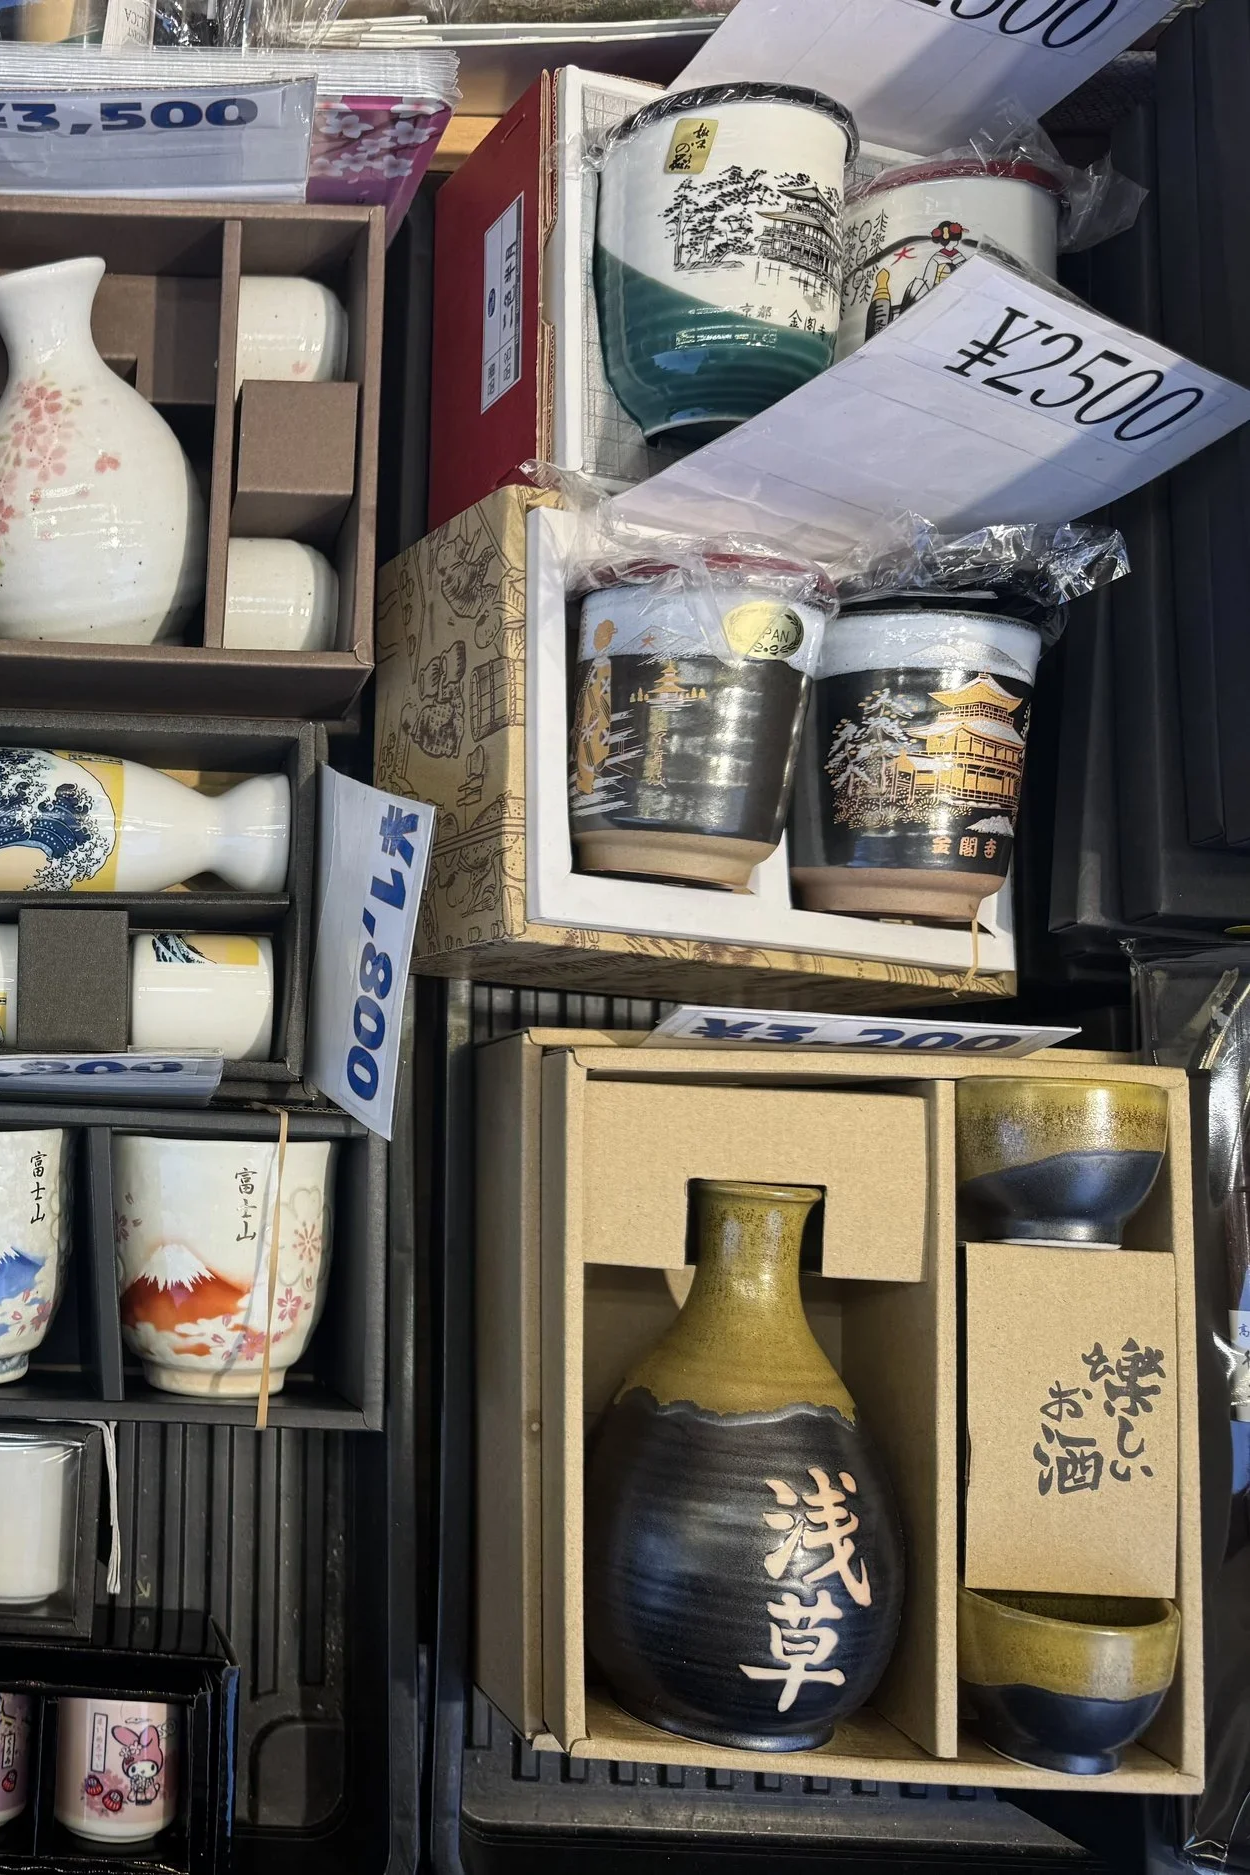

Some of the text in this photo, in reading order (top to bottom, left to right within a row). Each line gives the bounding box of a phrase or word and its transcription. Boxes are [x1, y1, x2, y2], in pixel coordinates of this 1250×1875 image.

[788, 309, 827, 341] 金閣寺
[945, 306, 1204, 442] ¥2500
[932, 835, 997, 859] 金閣寺
[346, 804, 419, 1100] ¥1,800
[30, 1150, 47, 1225] 富士山
[234, 1167, 258, 1243] 富士山
[1033, 1380, 1104, 1496] お酒
[739, 1466, 872, 1713] 浅草
